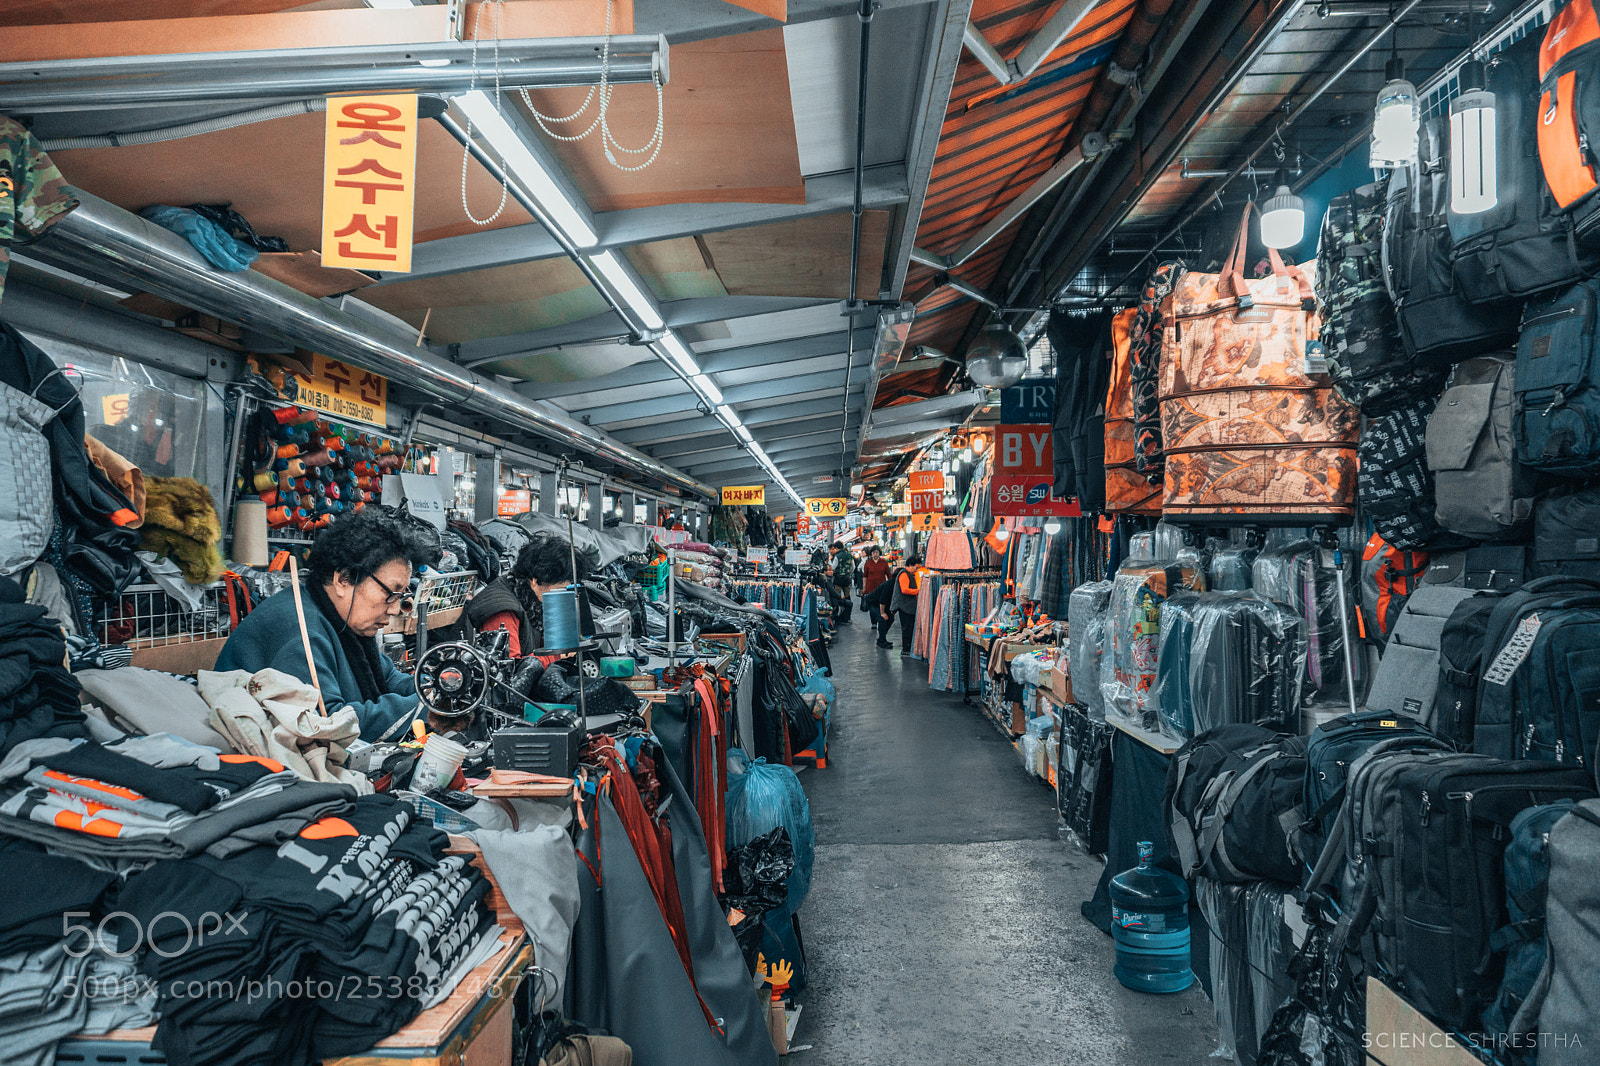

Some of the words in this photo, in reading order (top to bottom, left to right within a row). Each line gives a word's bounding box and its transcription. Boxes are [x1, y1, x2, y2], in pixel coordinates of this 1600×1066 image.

[334, 102, 405, 261] 옷수선
[296, 387, 330, 409] 씨아줌마
[333, 397, 374, 421] 010-7550-8362
[1002, 432, 1049, 467] BY
[918, 475, 935, 485] TRY
[996, 484, 1024, 504] 송월
[913, 493, 942, 510] BYC
[277, 840, 329, 874] I
[340, 834, 373, 864] 대한민국
